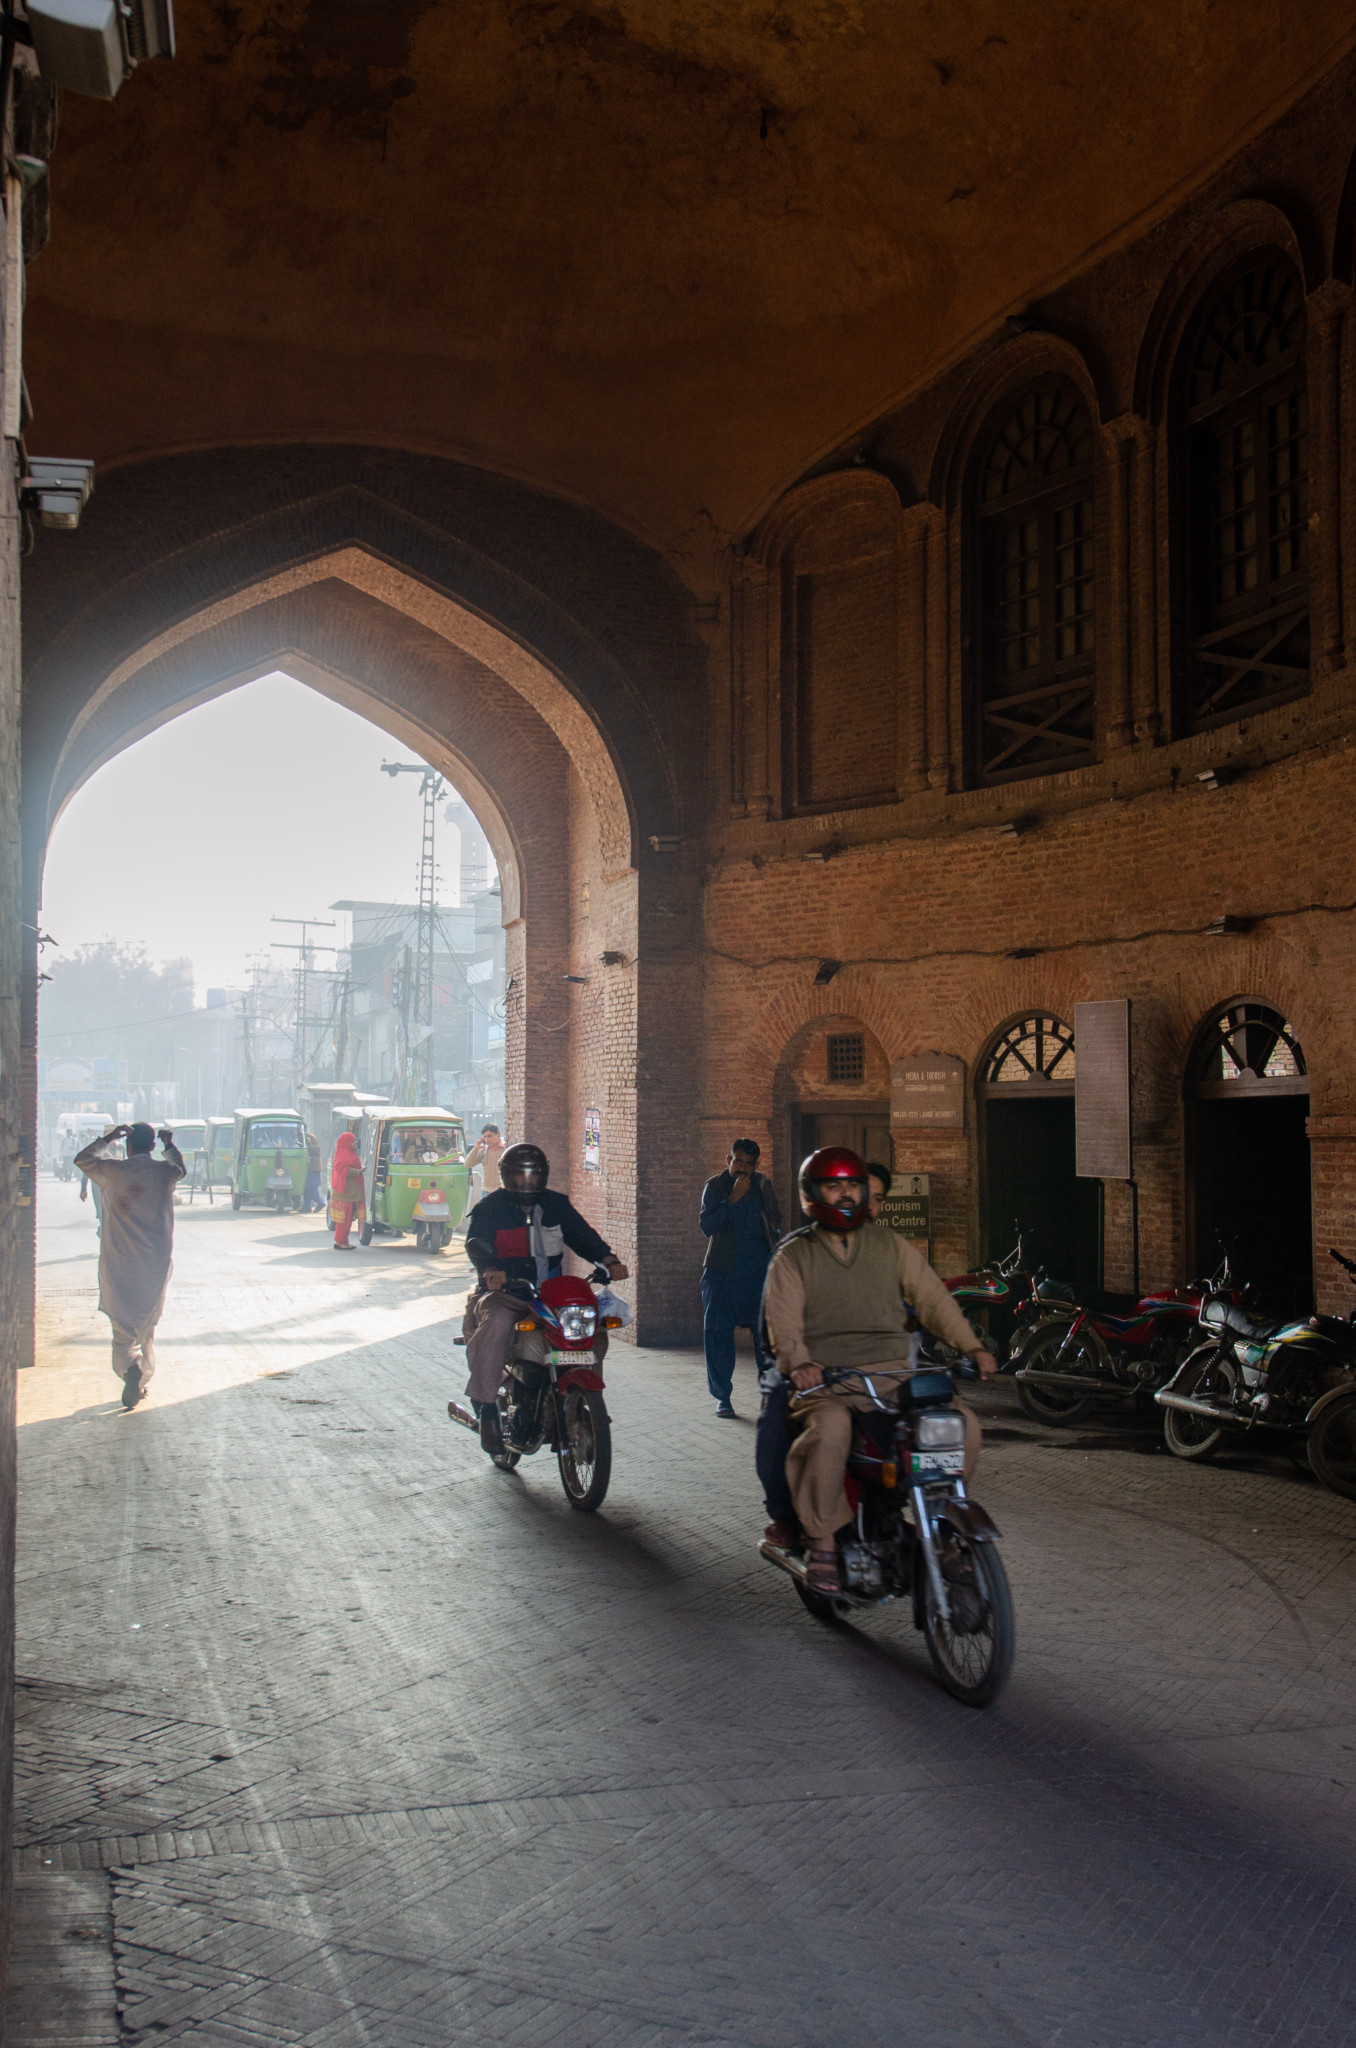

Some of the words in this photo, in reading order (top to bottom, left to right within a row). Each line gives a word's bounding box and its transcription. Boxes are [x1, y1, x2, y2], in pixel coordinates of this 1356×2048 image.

[905, 1071, 920, 1081] MEDIA
[920, 1071, 925, 1081] &
[926, 1071, 946, 1080] TOURISM
[929, 1084, 945, 1092] CENTRE
[881, 1200, 921, 1212] Tourism
[891, 1215, 926, 1227] Centre
